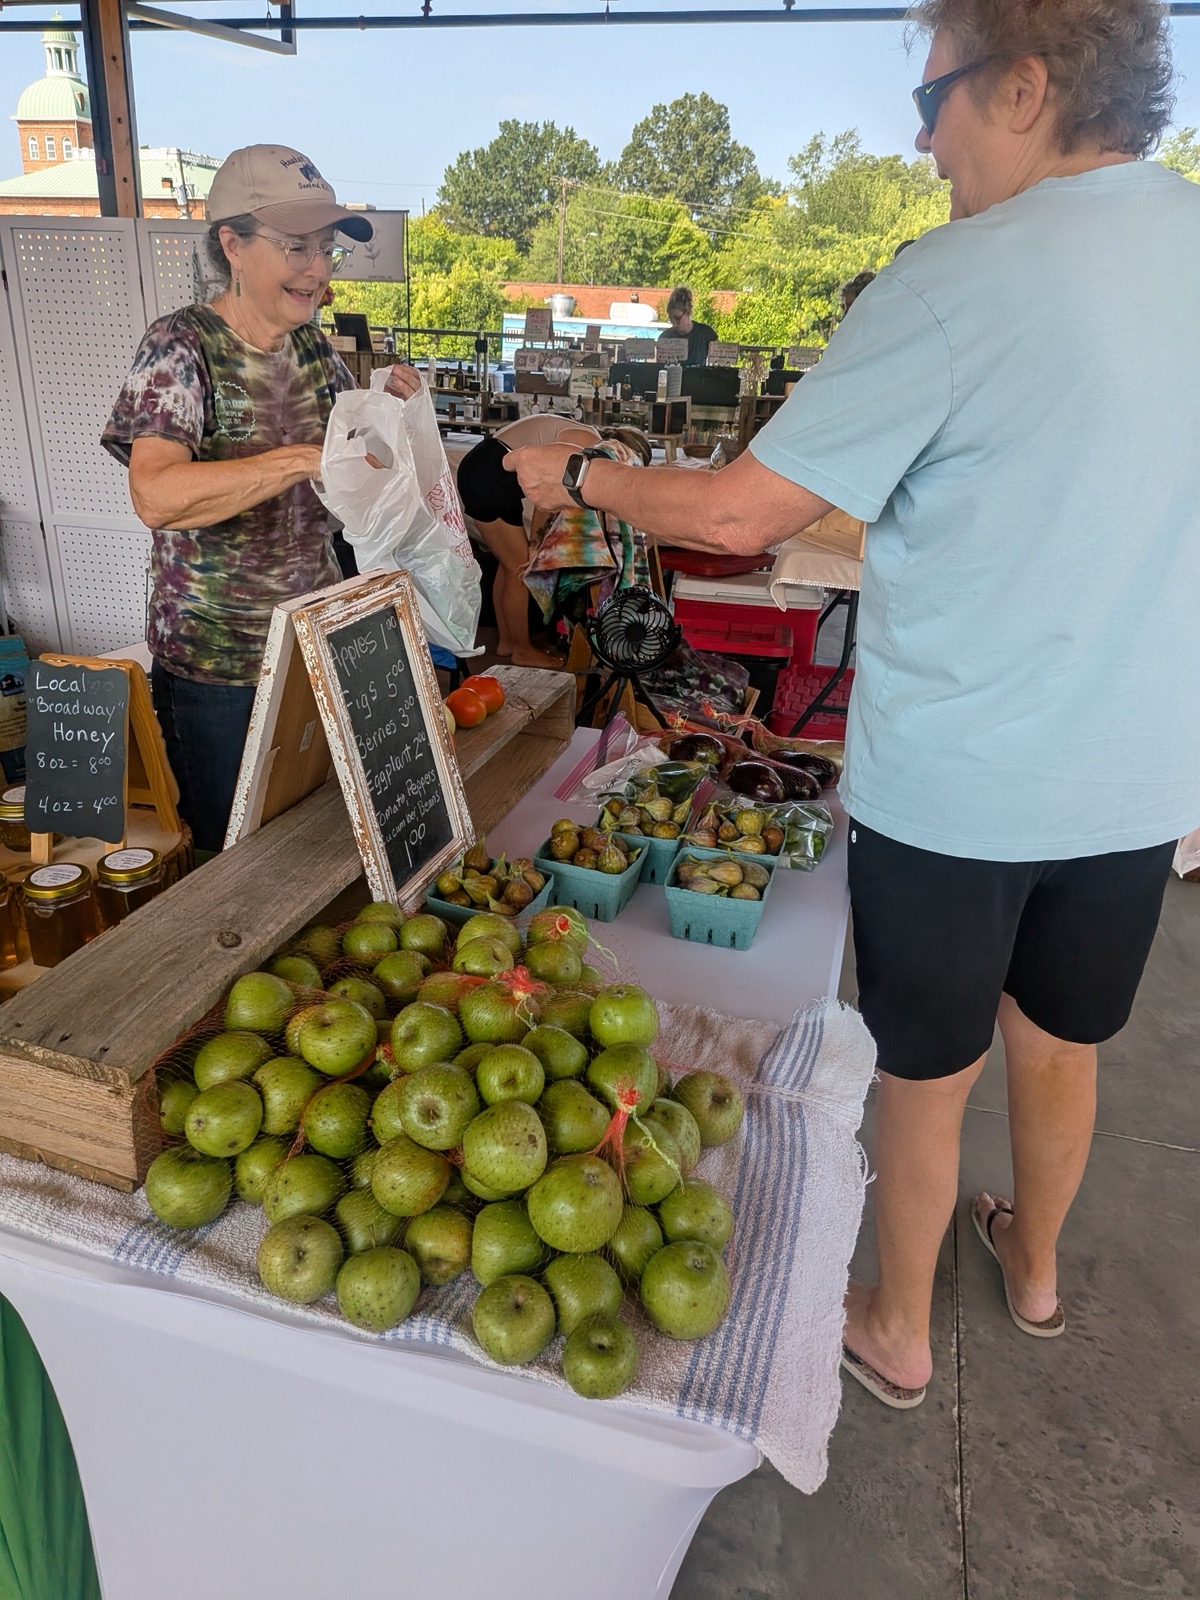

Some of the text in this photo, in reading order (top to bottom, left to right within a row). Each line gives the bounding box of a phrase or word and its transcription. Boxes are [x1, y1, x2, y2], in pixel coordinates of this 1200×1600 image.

[330, 631, 378, 677] Apples
[35, 671, 87, 693] Local
[53, 721, 115, 754] Honey
[366, 743, 412, 796] Eggplant
